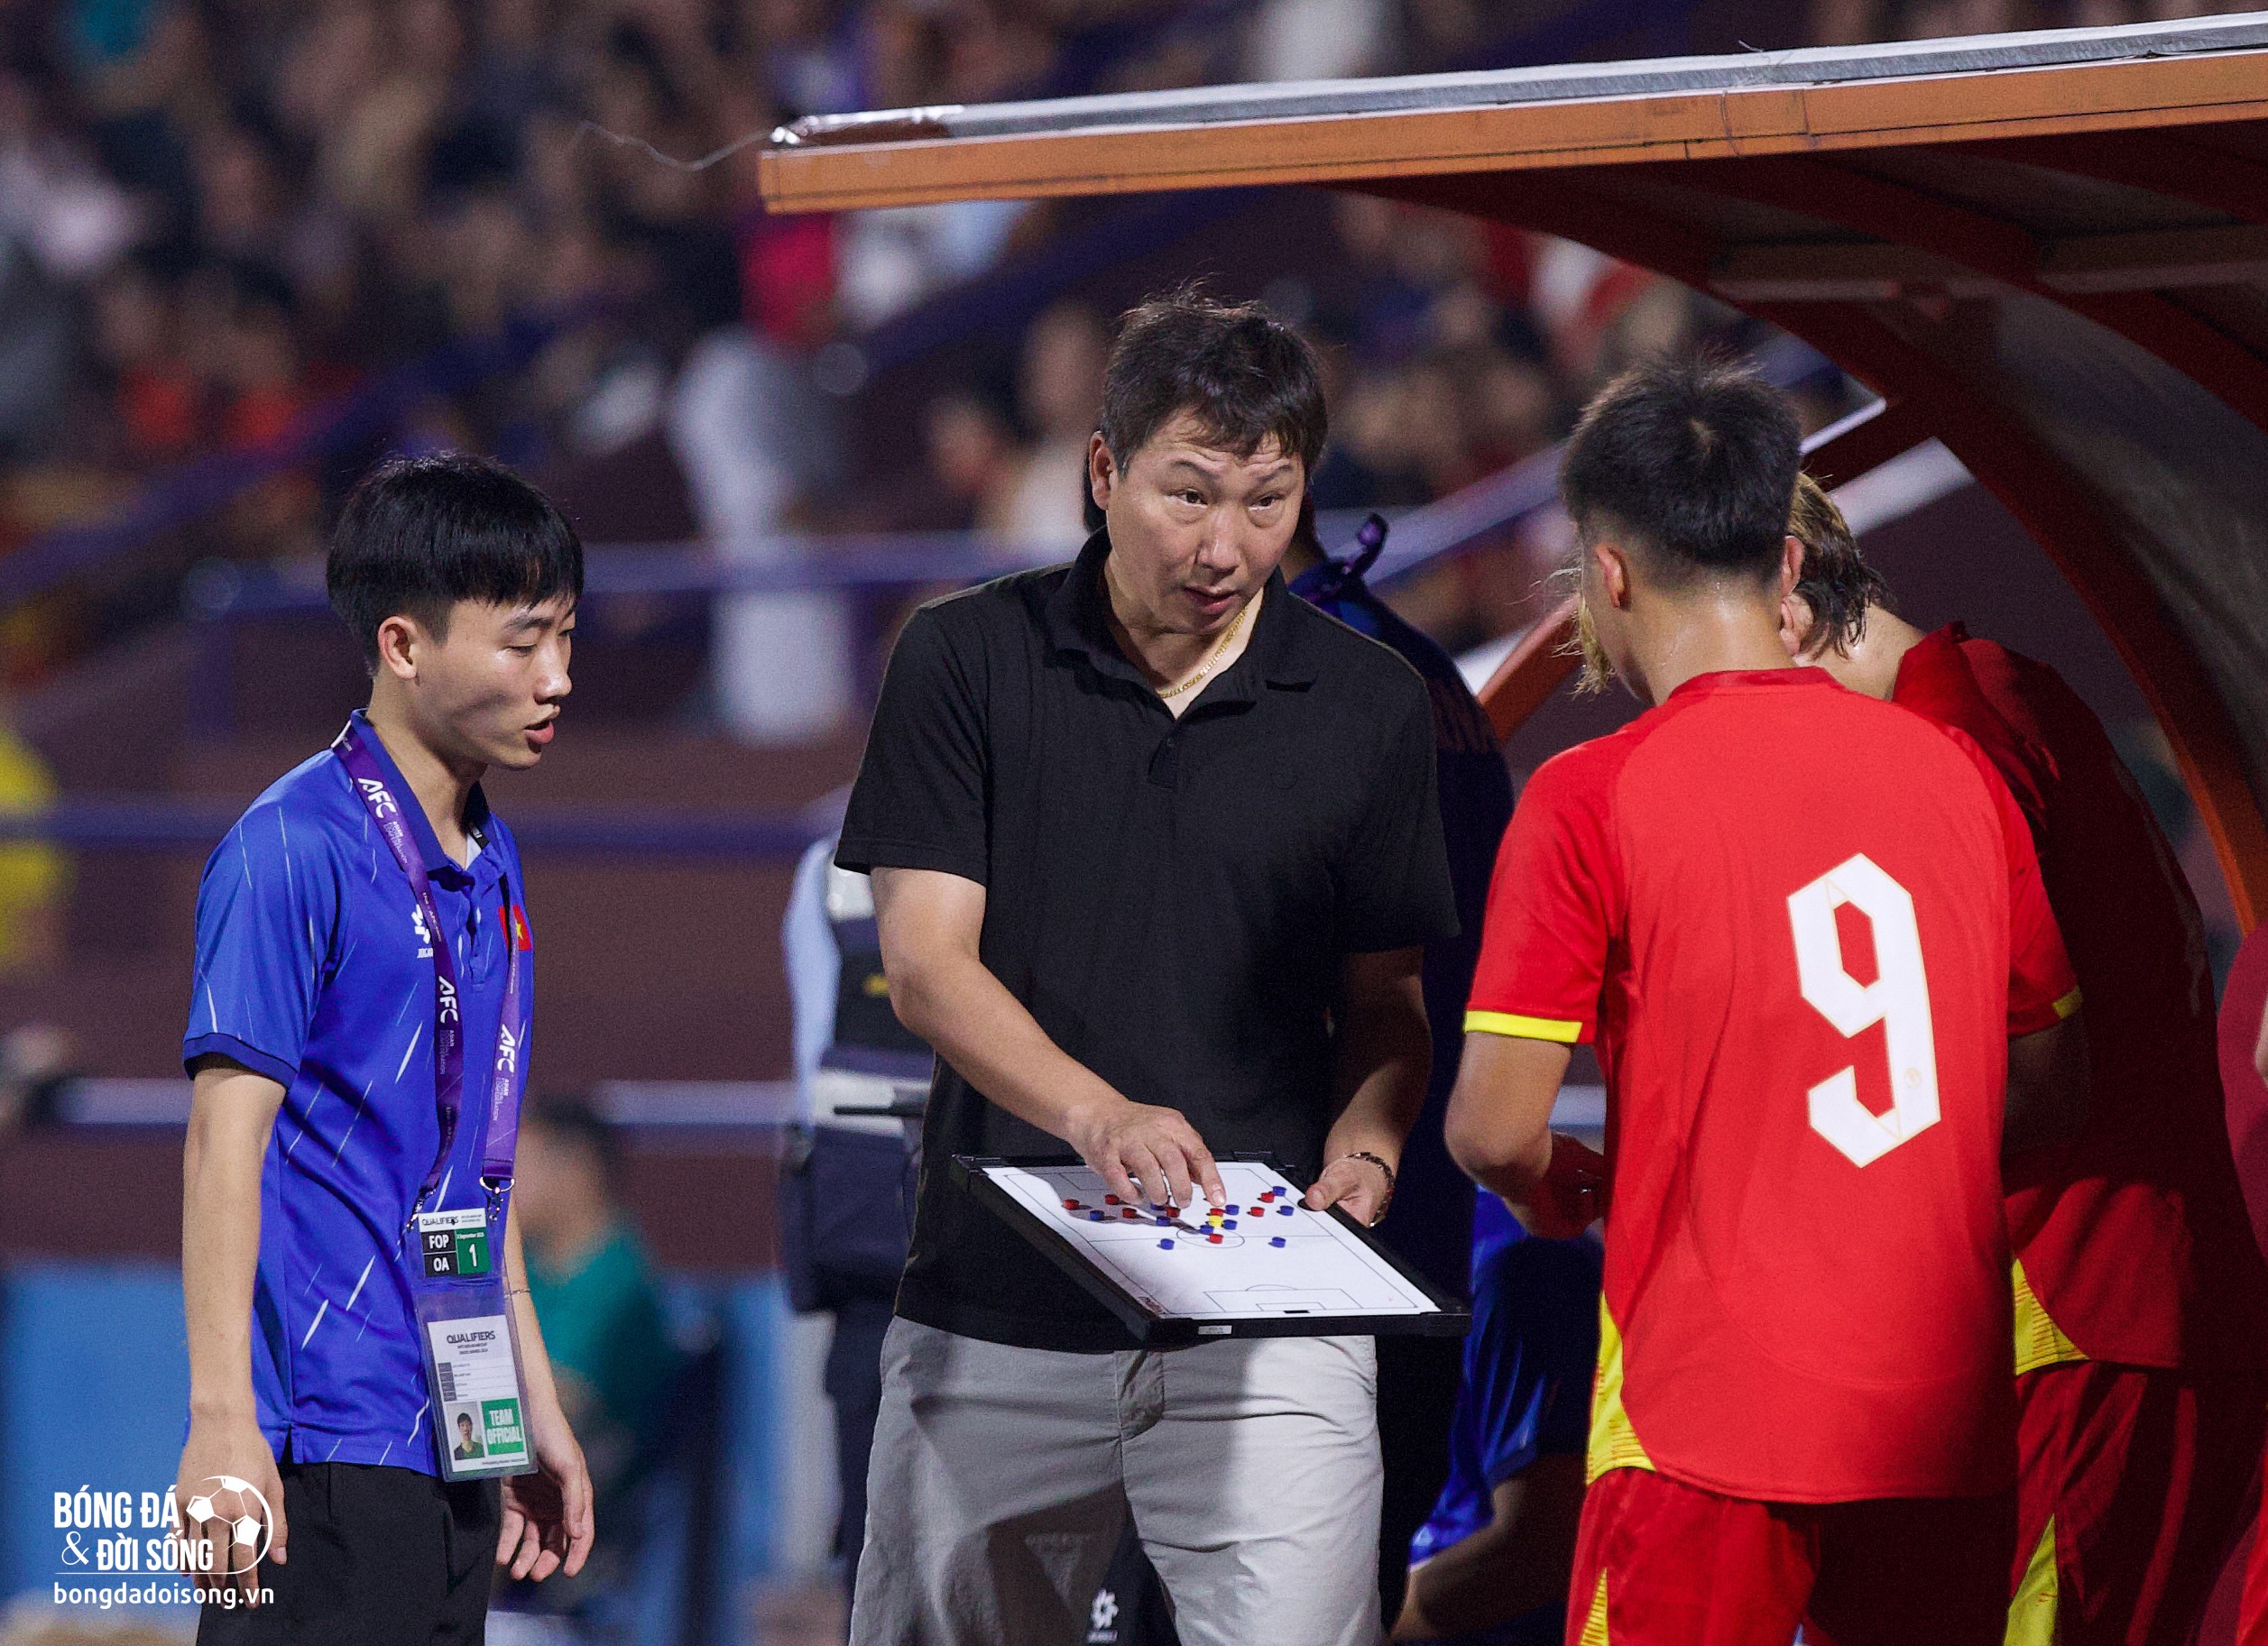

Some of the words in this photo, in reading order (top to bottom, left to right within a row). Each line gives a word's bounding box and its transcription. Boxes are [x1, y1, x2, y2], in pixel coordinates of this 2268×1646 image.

[357, 777, 398, 819] AFC
[438, 975, 459, 1024] AFC
[1787, 852, 1941, 1168] 9
[497, 1024, 516, 1073] AFC
[429, 1234, 449, 1249] FOP
[433, 1256, 450, 1272] OA
[469, 1243, 477, 1267] 1
[447, 1330, 496, 1344] QUALIFIERS
[489, 1408, 514, 1426] TEAM
[487, 1426, 522, 1445] OFFICIAL
